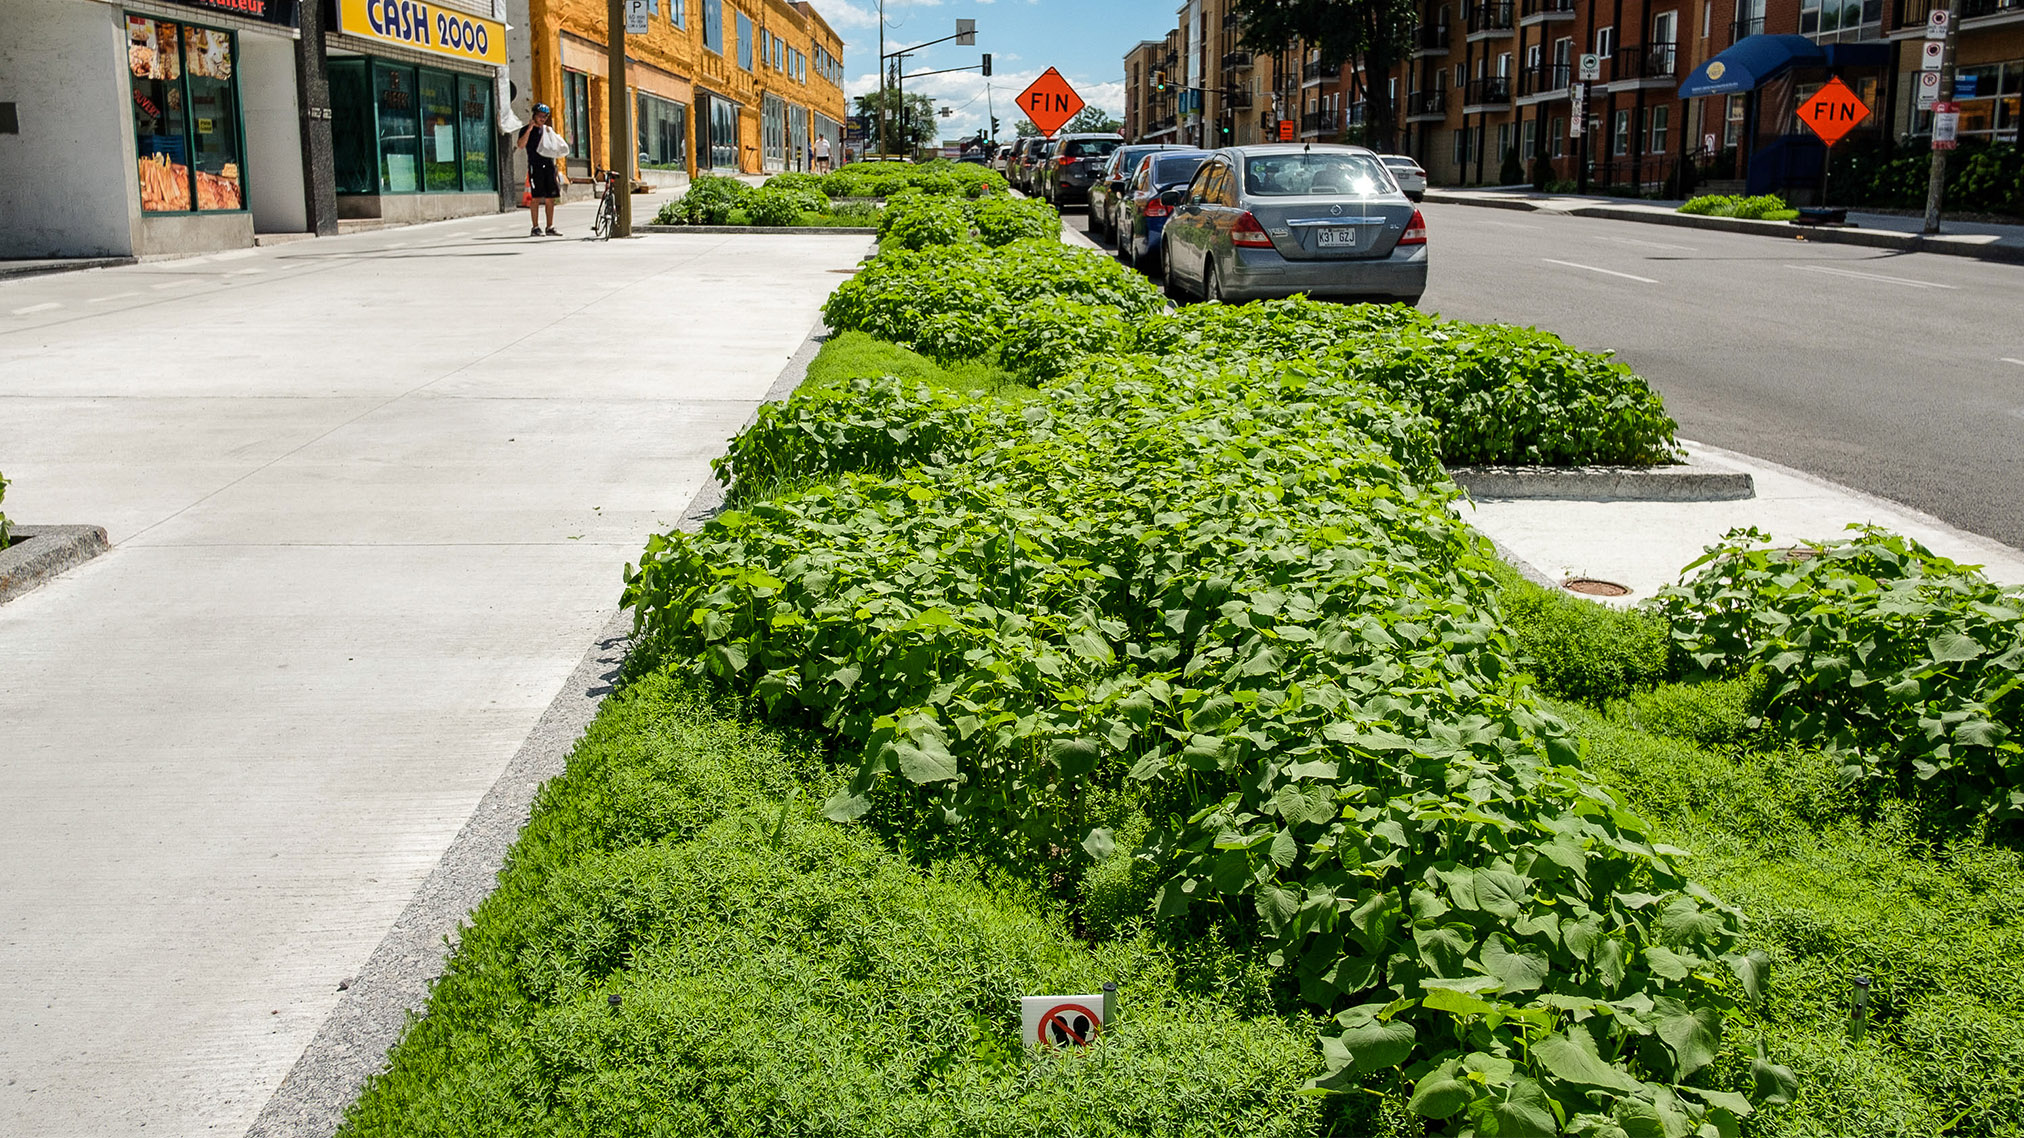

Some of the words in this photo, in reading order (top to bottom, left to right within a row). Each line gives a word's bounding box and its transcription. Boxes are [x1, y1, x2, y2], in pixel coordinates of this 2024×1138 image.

[633, 1, 641, 13] P
[367, 0, 431, 46] CASH
[437, 12, 488, 56] 2000
[1031, 92, 1069, 113] FIN
[1814, 102, 1855, 121] FIN
[1319, 232, 1334, 243] K31
[1339, 231, 1355, 243] GZJ
